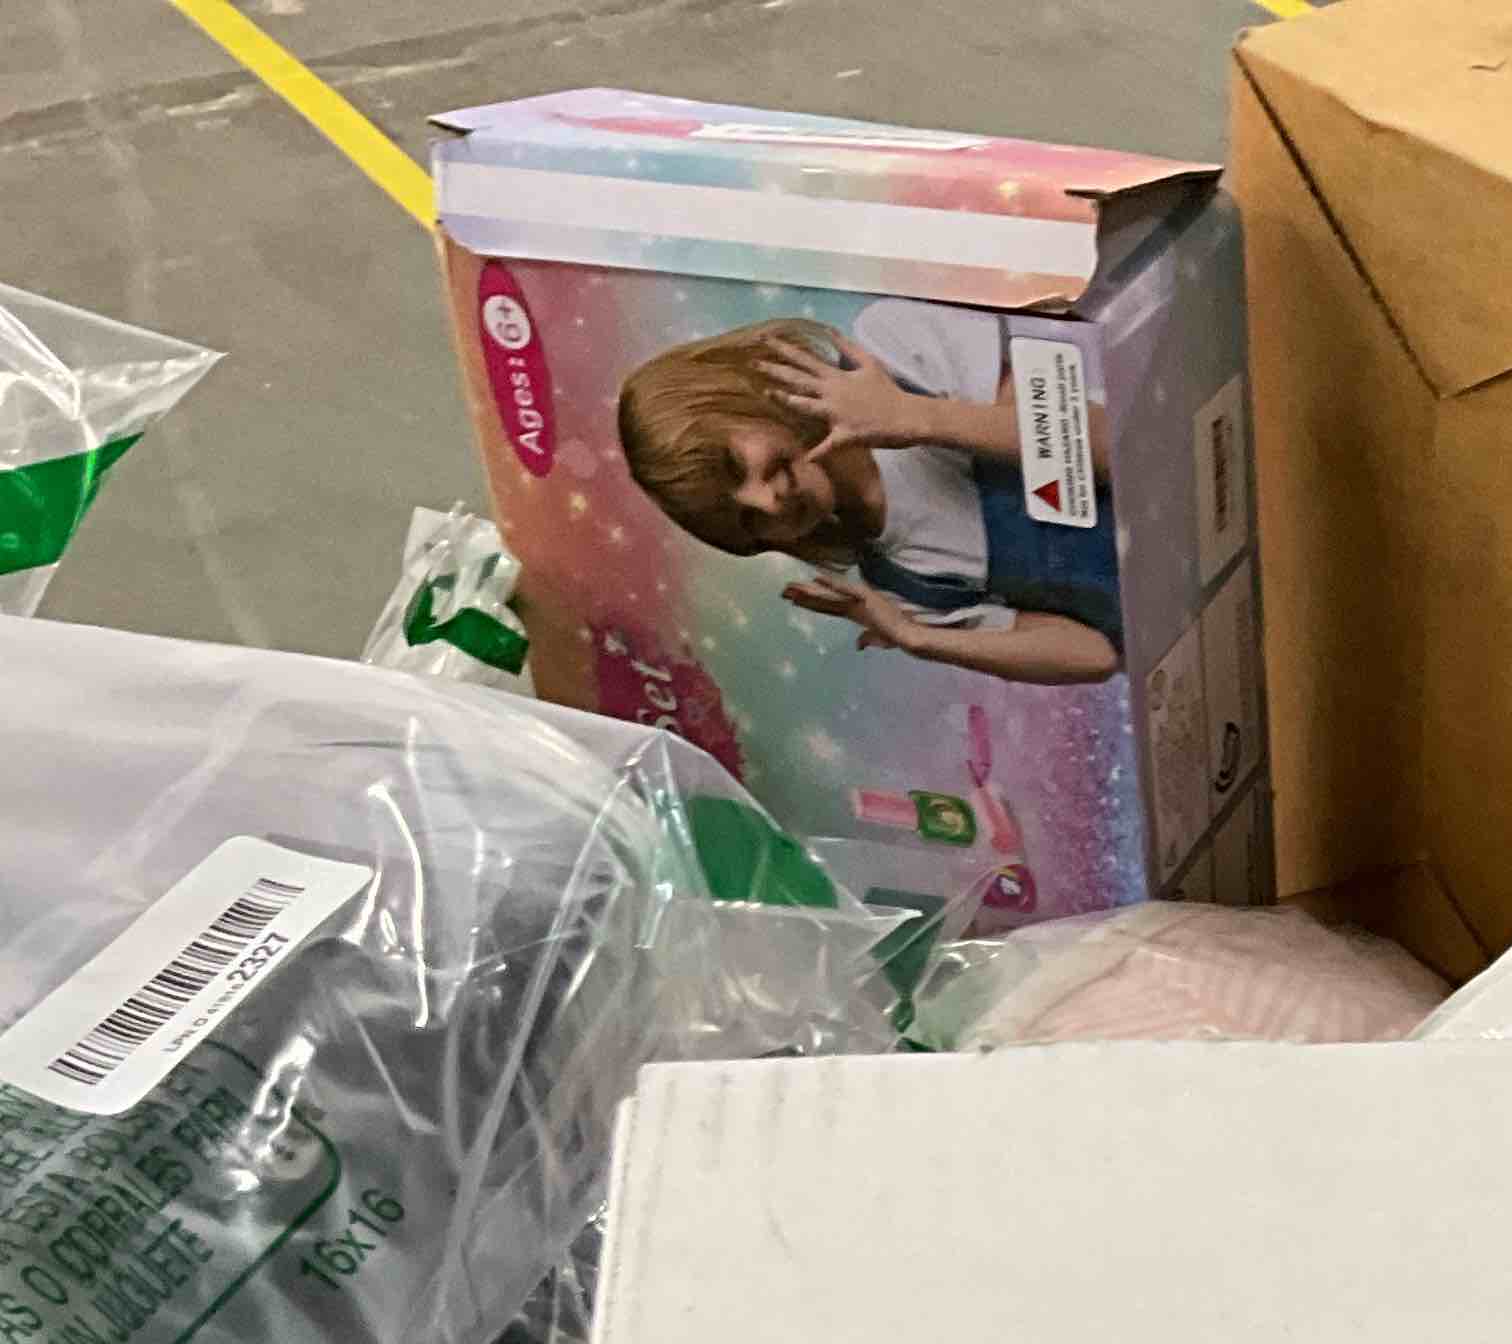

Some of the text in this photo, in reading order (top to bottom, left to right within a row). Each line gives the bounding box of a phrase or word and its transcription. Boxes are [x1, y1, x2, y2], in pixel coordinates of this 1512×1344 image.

[508, 356, 545, 455] Ages:
[227, 932, 289, 981] 2327
[300, 1188, 405, 1291] 16x16
